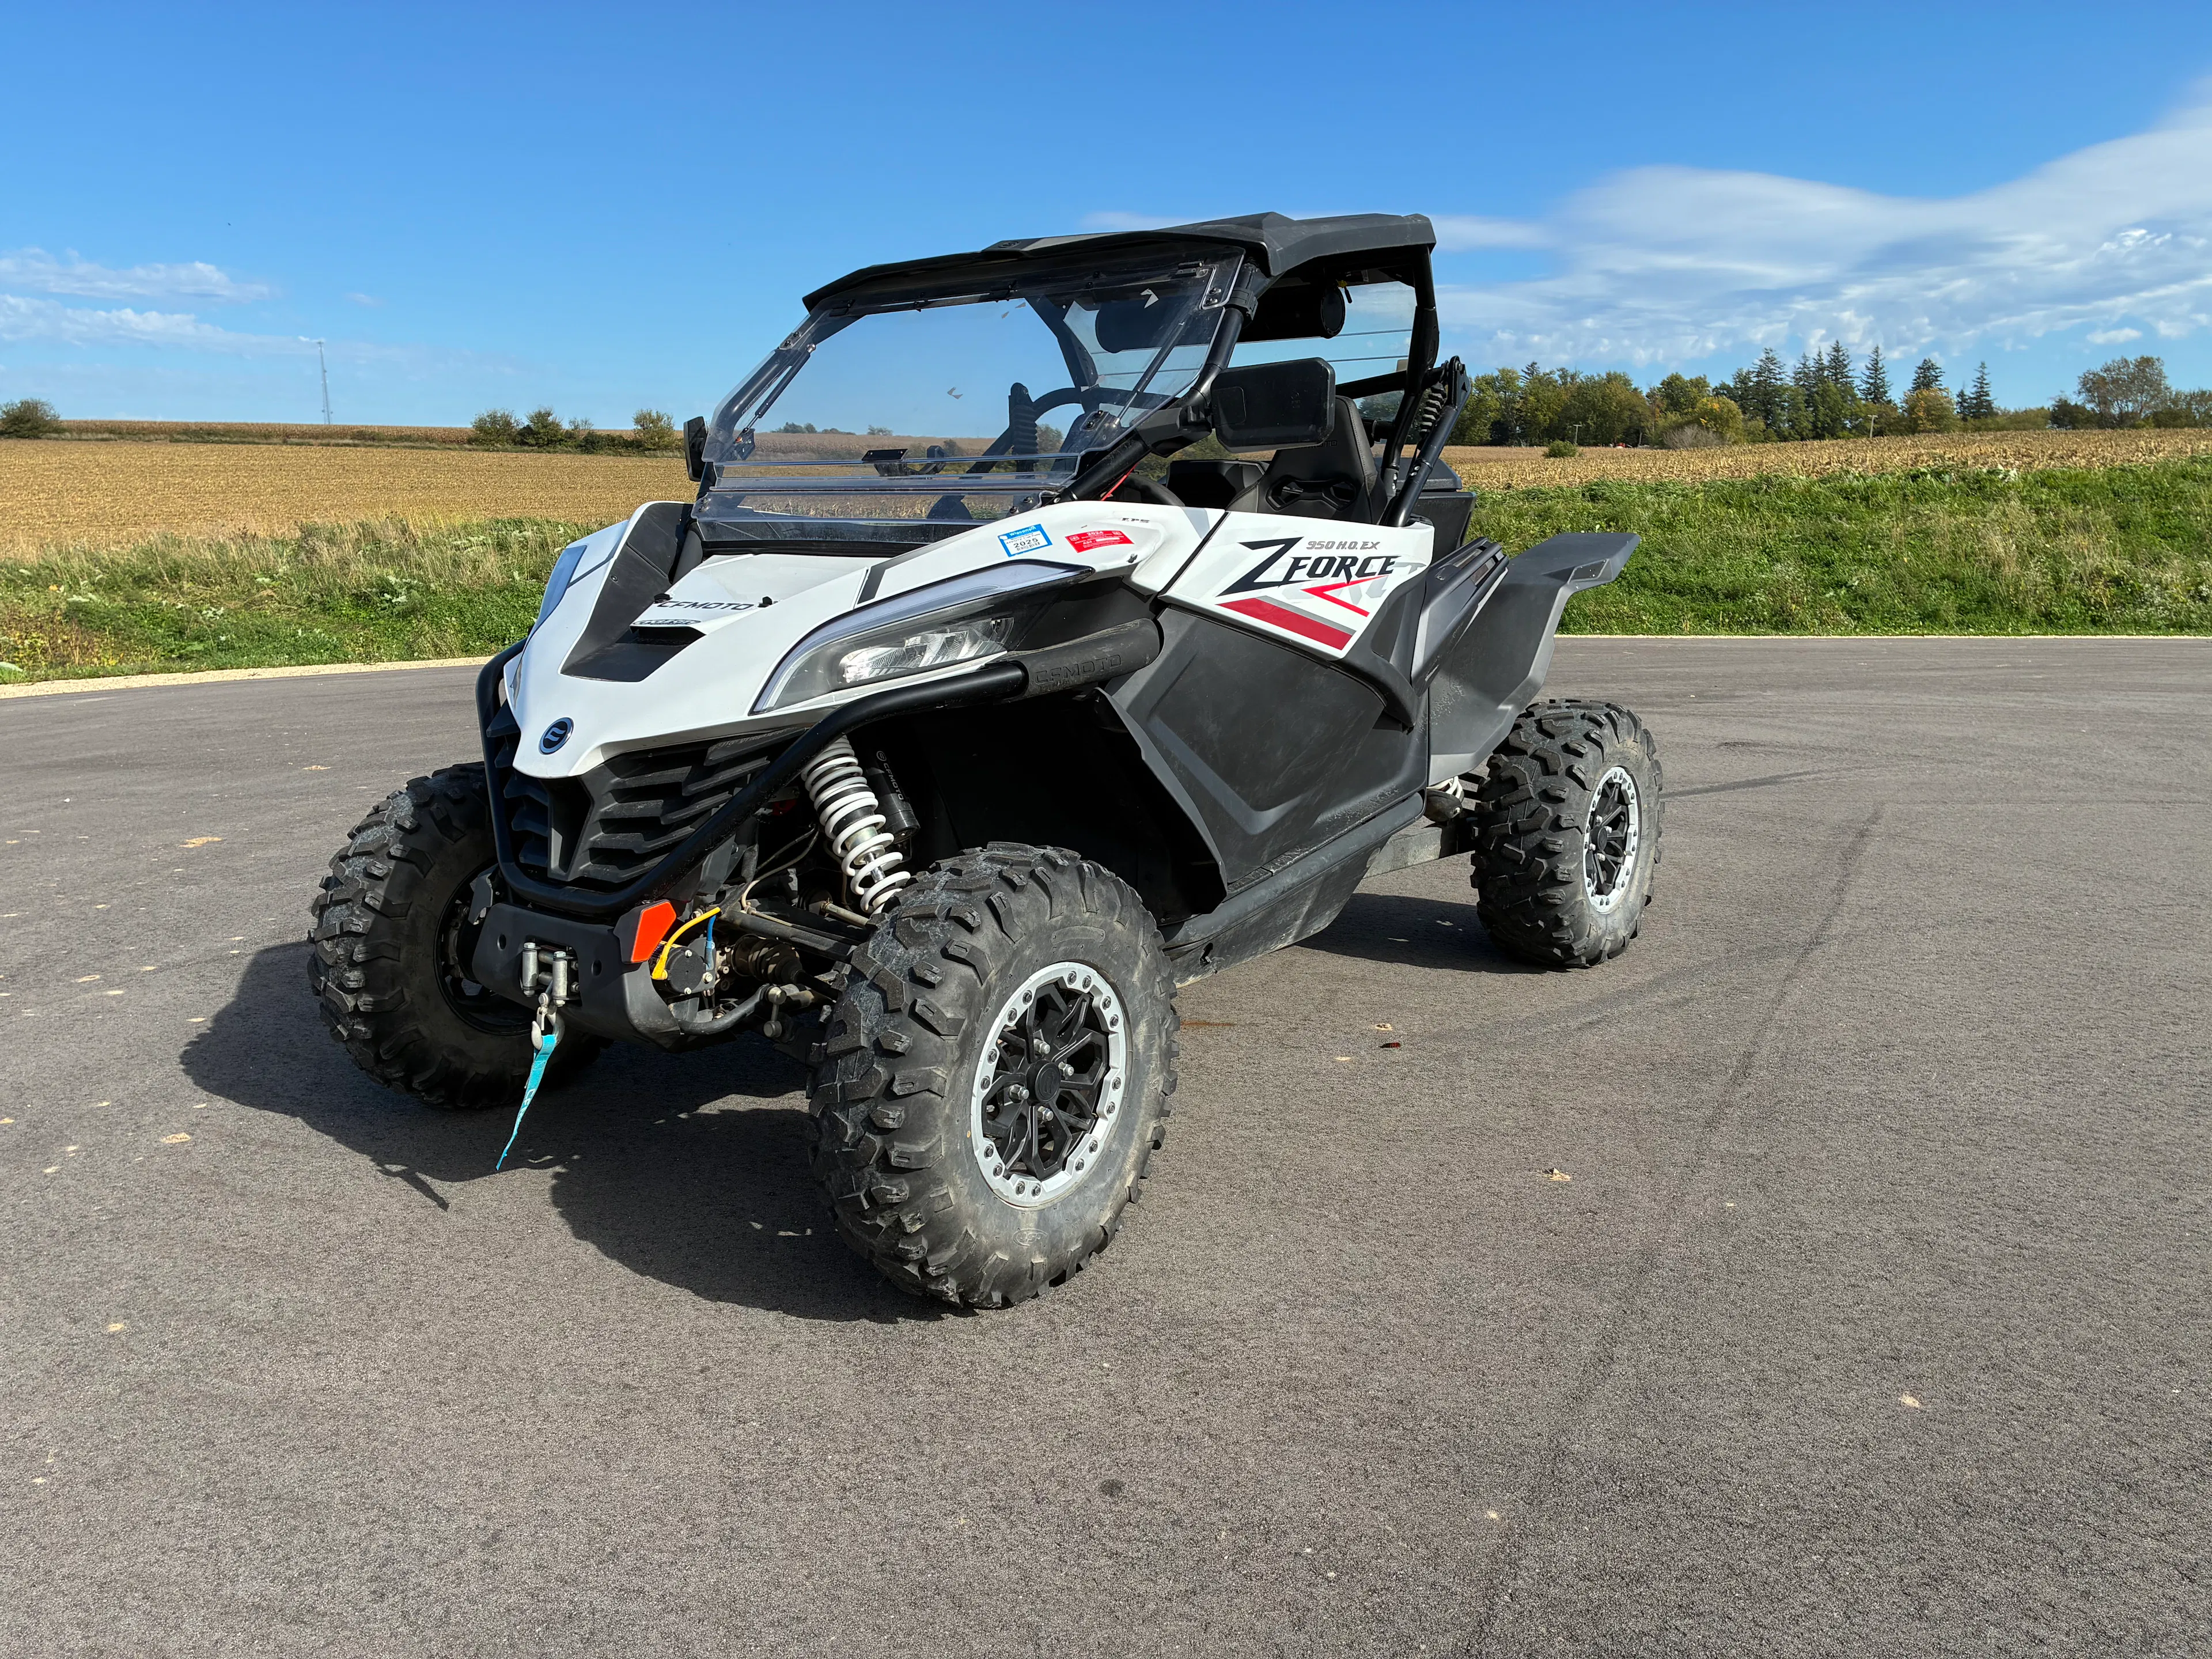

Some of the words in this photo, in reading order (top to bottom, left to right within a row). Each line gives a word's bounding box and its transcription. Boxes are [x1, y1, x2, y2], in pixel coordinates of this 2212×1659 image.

[1013, 537, 1038, 548] 2025
[1306, 541, 1334, 550] 950
[1360, 541, 1381, 550] EX
[1215, 536, 1316, 597] Z
[1279, 555, 1402, 585] FORCE
[657, 601, 755, 611] CFMOTO
[1035, 654, 1122, 684] CFMOTO
[884, 763, 904, 801] CFMOTO
